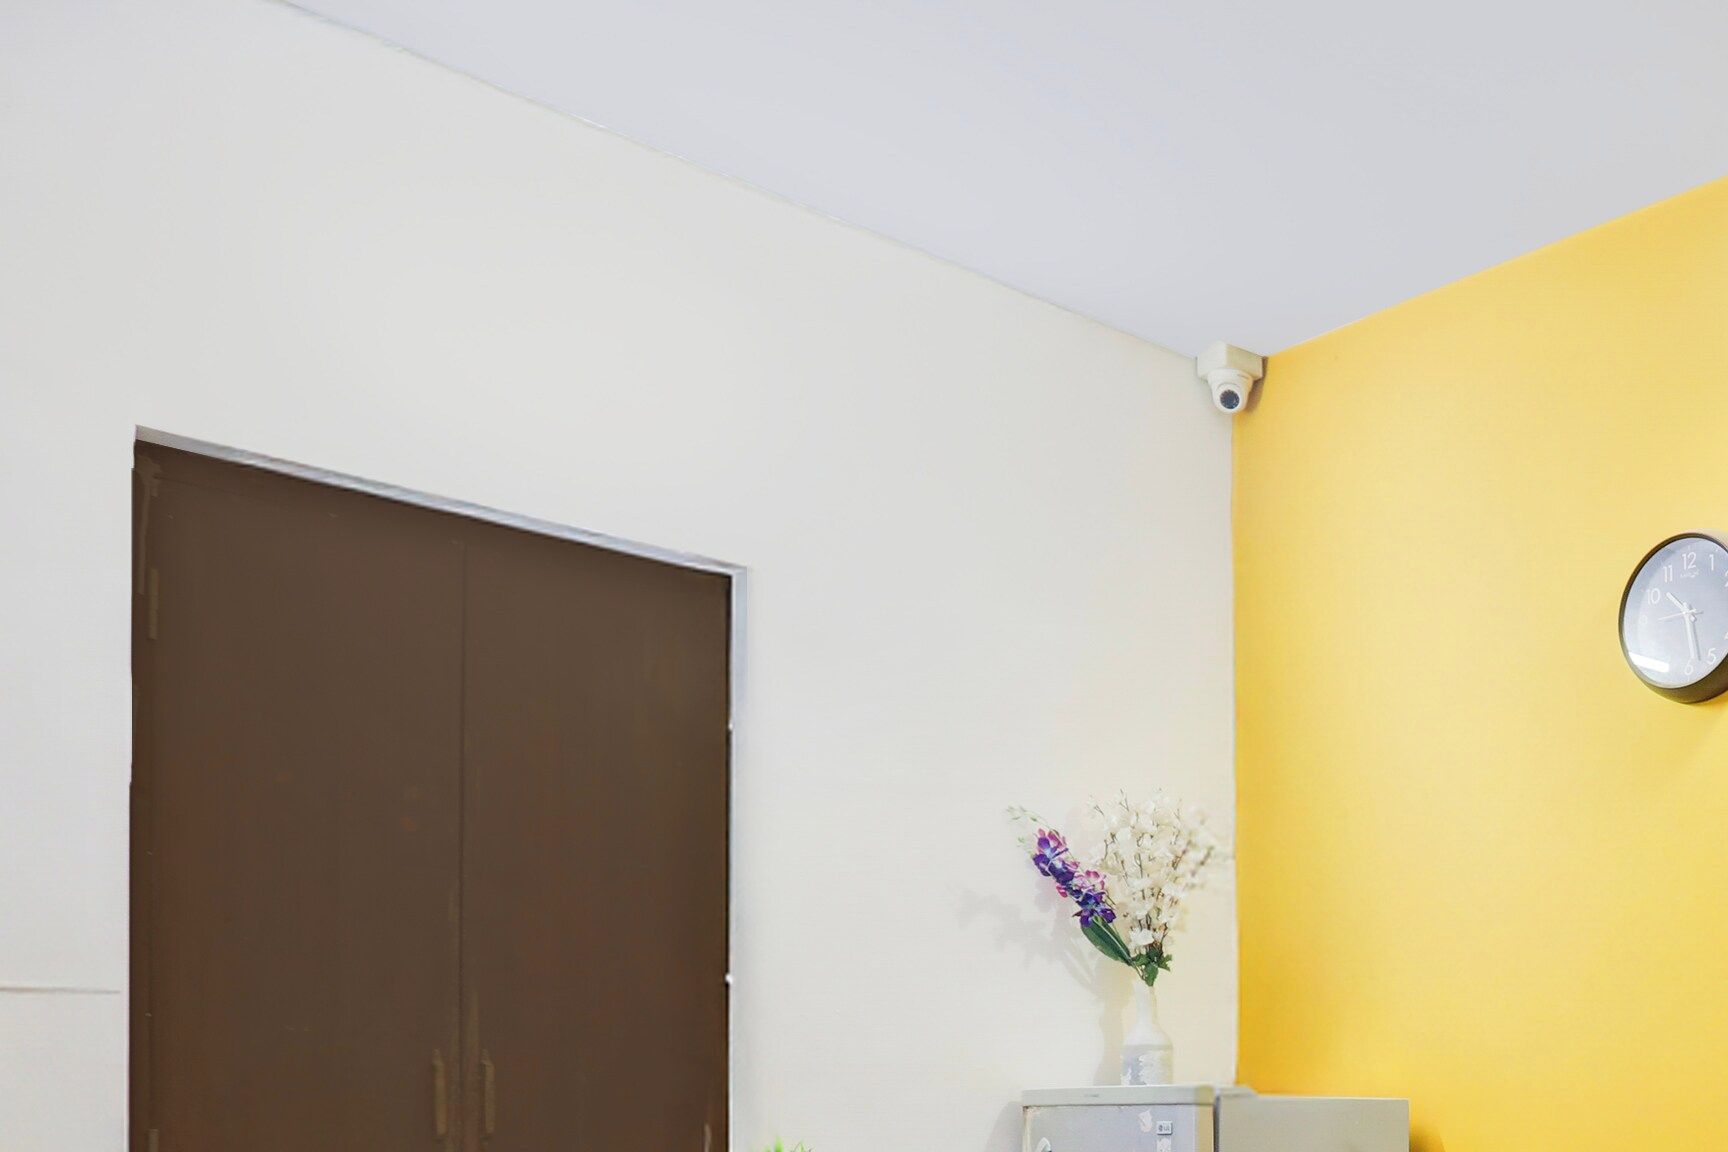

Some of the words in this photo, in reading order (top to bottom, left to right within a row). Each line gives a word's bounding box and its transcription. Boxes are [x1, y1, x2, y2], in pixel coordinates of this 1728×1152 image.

[1682, 552, 1696, 570] 12
[1709, 553, 1715, 571] 1
[1663, 565, 1673, 583] 11
[1646, 588, 1661, 606] 10
[1707, 647, 1717, 665] 5
[1684, 656, 1694, 676] 6
